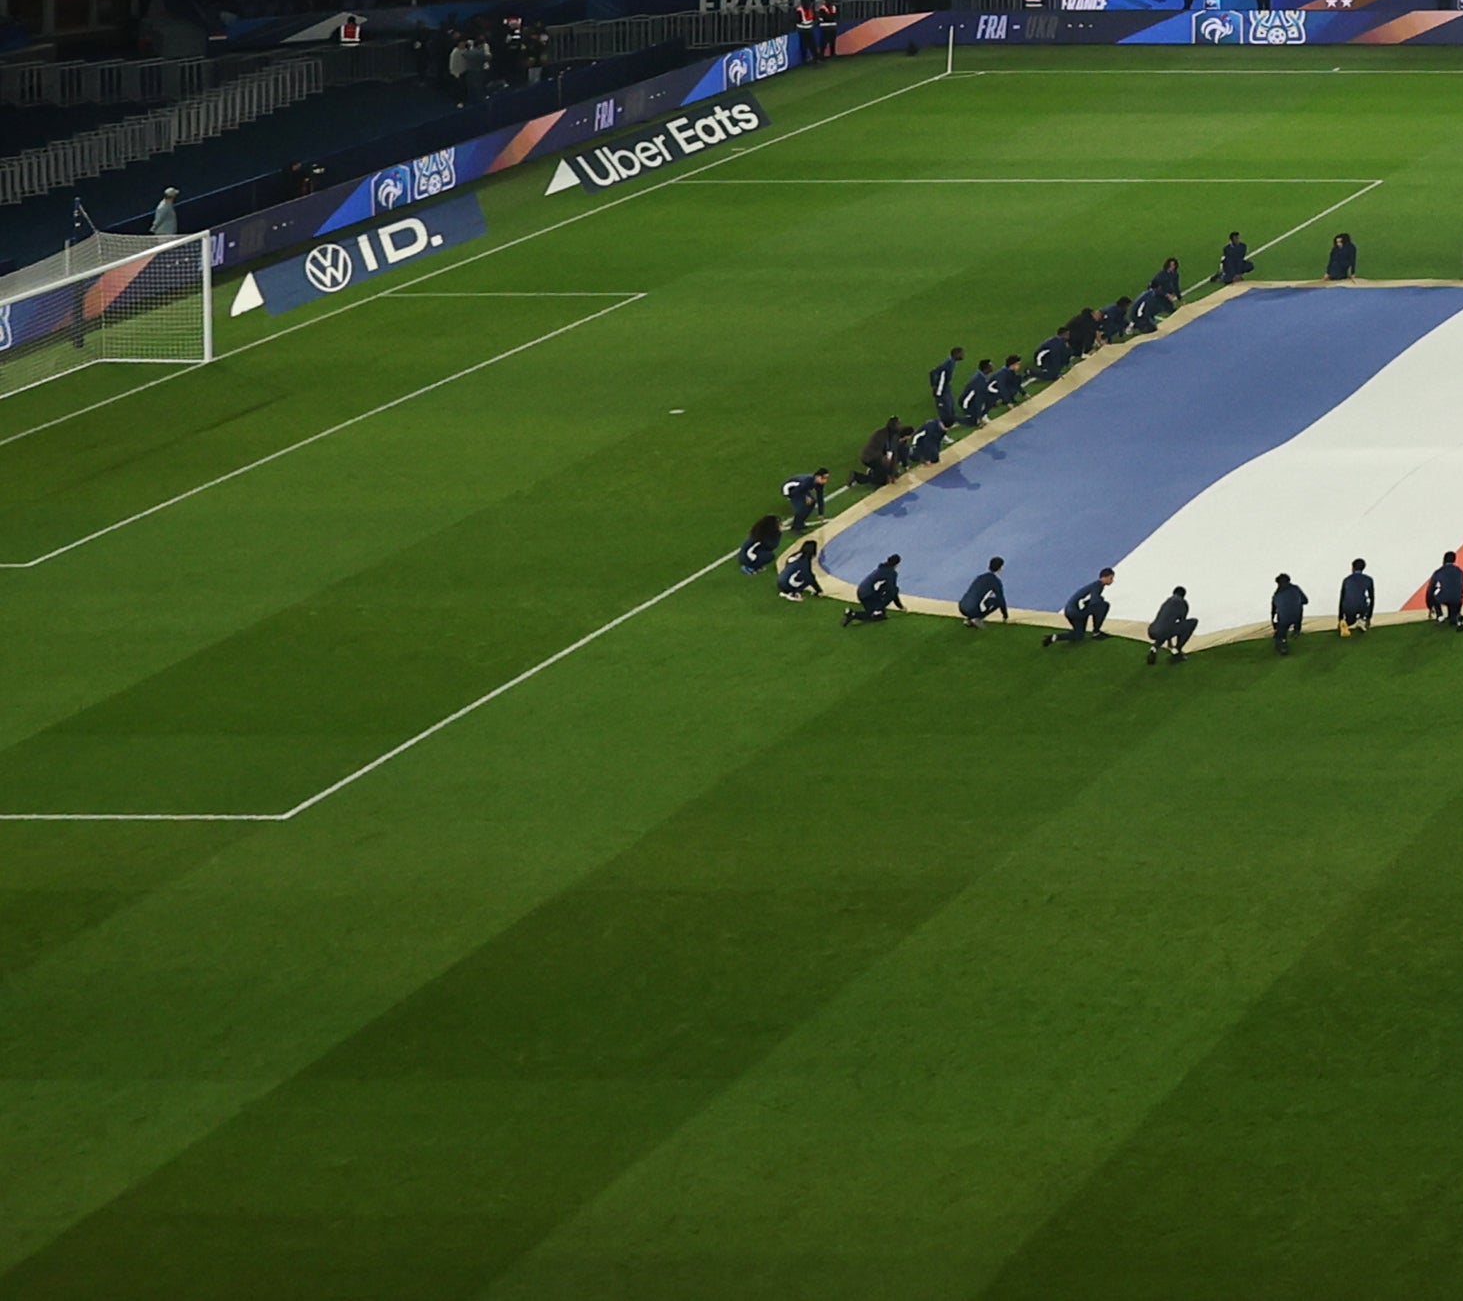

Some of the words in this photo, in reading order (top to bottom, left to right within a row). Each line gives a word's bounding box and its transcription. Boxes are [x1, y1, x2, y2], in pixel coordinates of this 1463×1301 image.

[976, 15, 1007, 39] FRA
[576, 135, 673, 187] Uber
[666, 102, 759, 154] Eats
